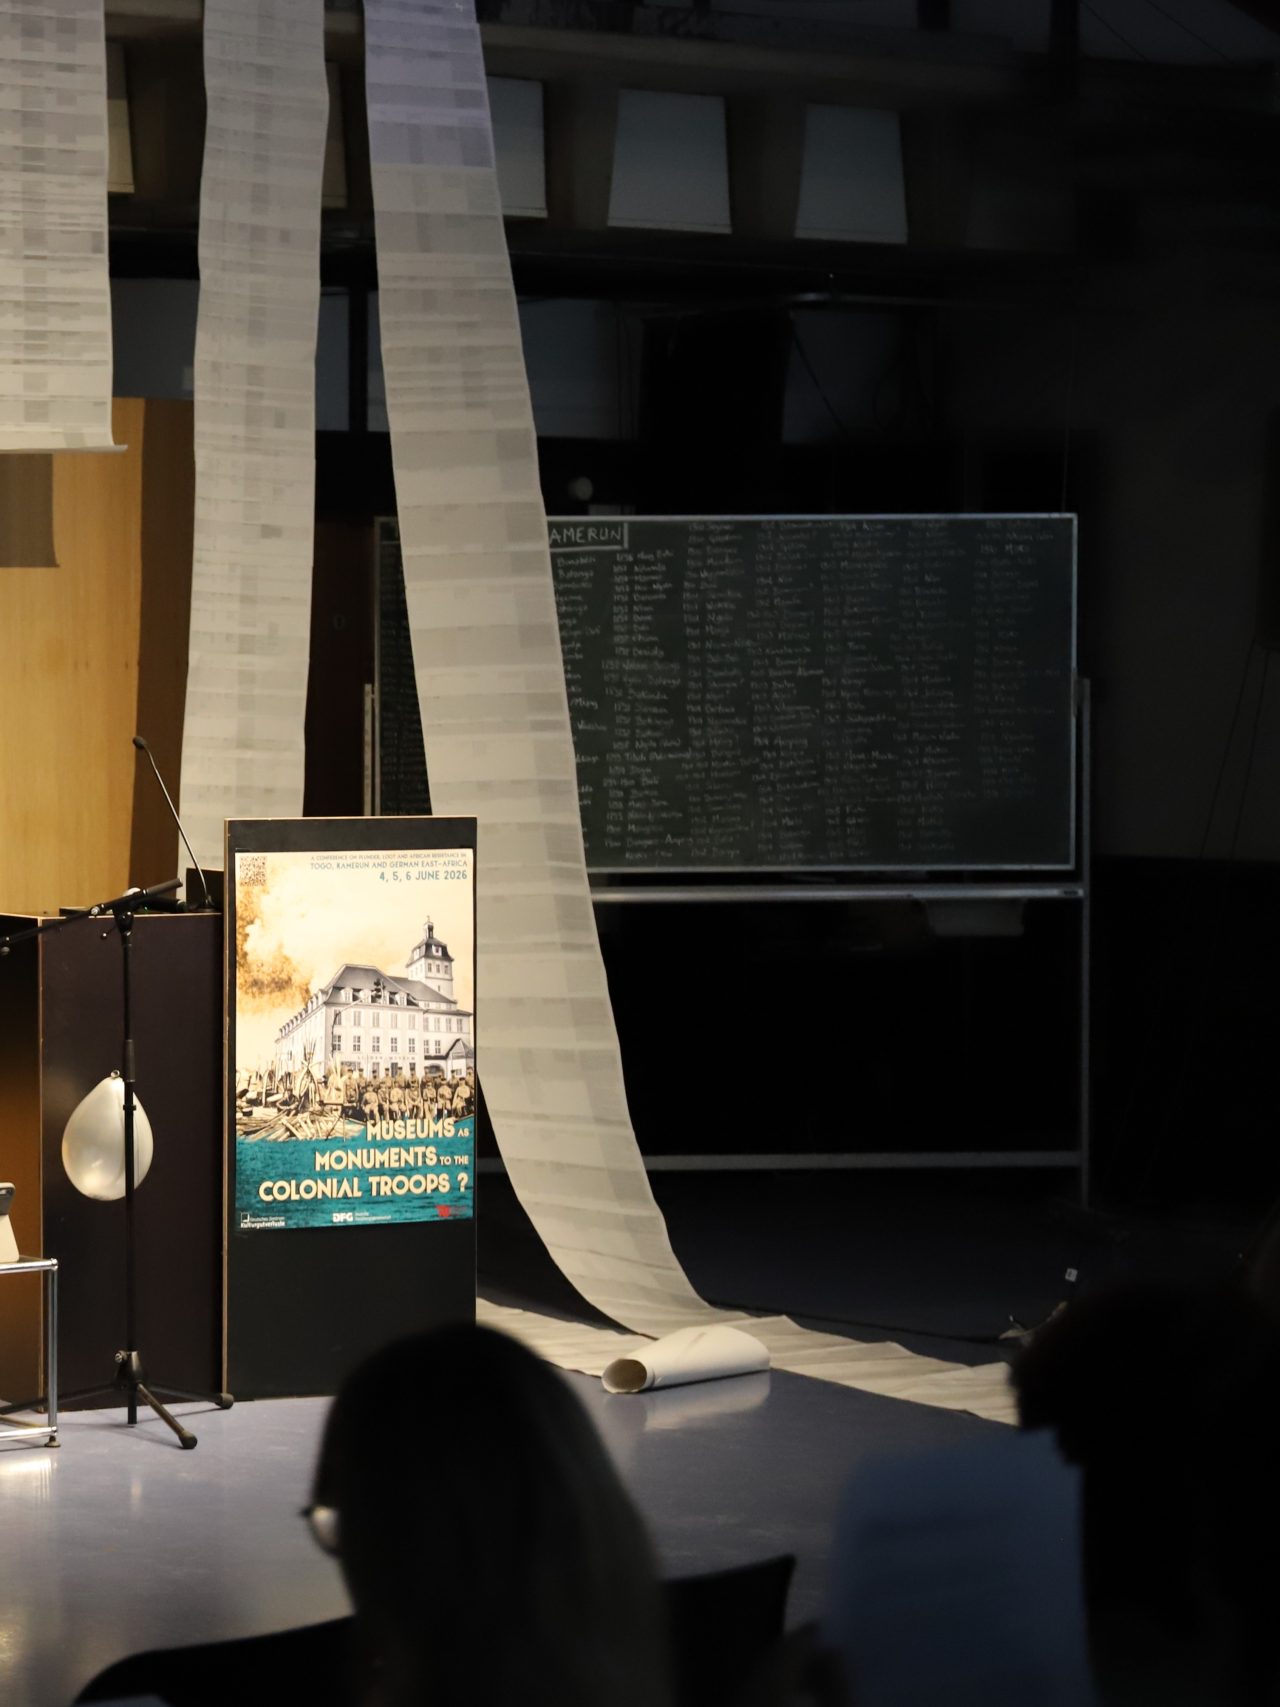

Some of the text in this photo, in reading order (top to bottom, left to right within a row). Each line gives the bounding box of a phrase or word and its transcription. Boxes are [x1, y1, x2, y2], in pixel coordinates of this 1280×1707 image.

[310, 858, 468, 871] TOGO, KAMERUN AND GERMAN EAST-AFRICA
[379, 870, 468, 883] 4, 5, 6 JUNE 2026
[366, 1118, 470, 1142] MUSEUMS AS
[315, 1146, 469, 1172] MONUMENTS TO THE
[258, 1172, 469, 1202] COLONIAL TROOPS ?
[332, 1211, 354, 1223] DFG
